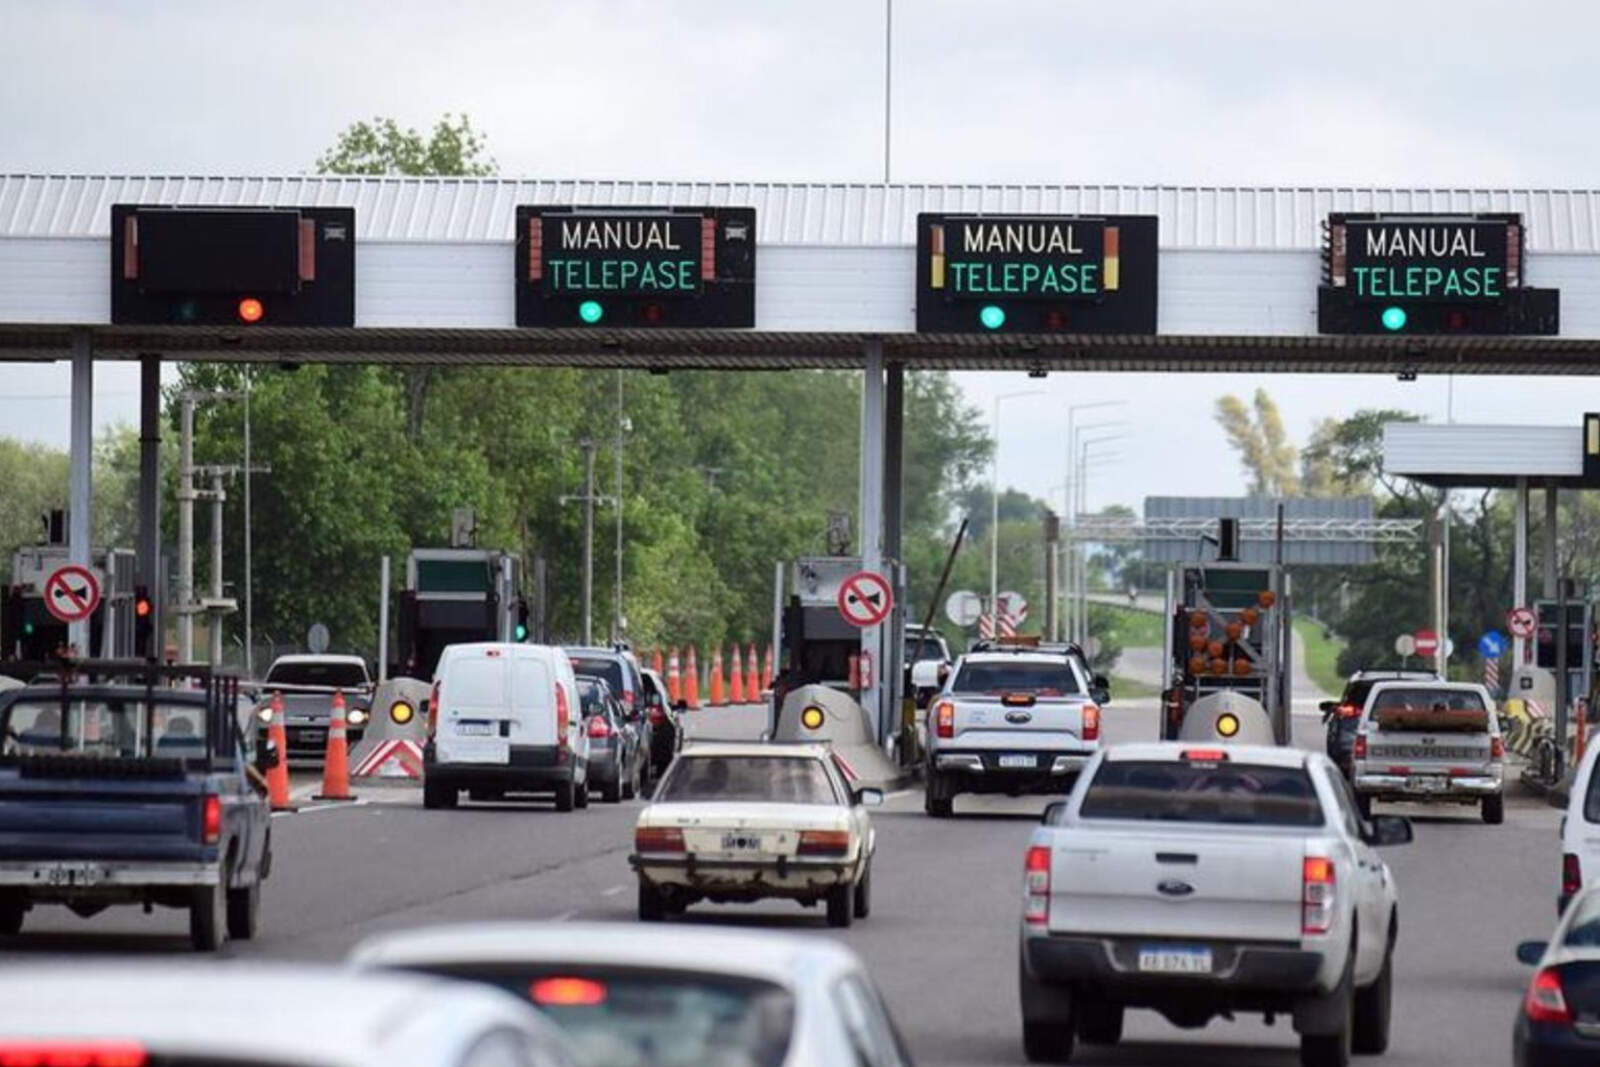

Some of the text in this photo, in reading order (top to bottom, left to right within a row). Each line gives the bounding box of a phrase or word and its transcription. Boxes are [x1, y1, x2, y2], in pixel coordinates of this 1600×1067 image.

[561, 221, 681, 250] MANUAL
[963, 224, 1083, 254] MANUAL
[1366, 227, 1485, 257] MANUAL
[548, 260, 695, 290] TELEPASE
[950, 263, 1098, 293] TELEPASE
[1353, 267, 1501, 296] TELEPASE
[1371, 744, 1484, 758] CHEVROLET
